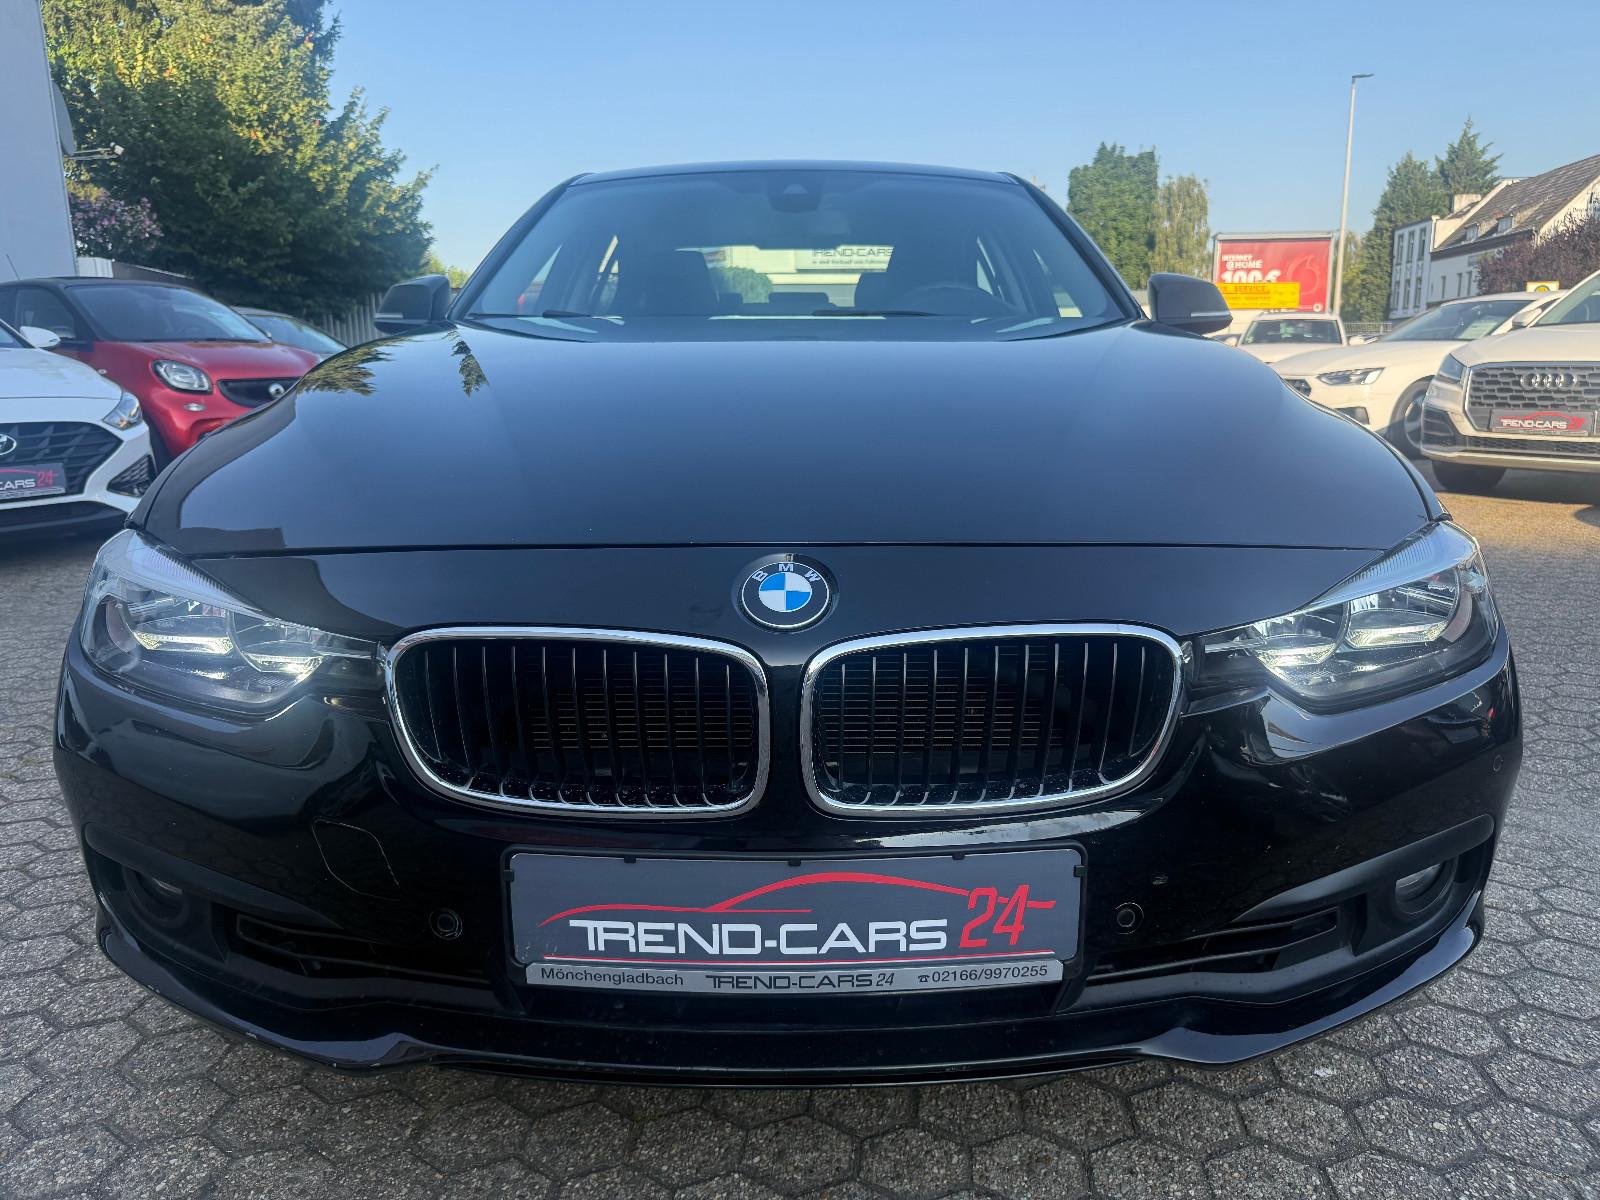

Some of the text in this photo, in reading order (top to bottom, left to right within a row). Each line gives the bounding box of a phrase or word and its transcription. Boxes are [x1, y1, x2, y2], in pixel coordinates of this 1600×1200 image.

[1501, 419, 1567, 429] TREND-CARS
[37, 470, 55, 487] 24
[752, 563, 822, 582] BMW
[569, 884, 1030, 955] TREND-CARS 24
[541, 965, 1048, 990] Mönchengladbach TREND-CARS 24 02166/9970255
